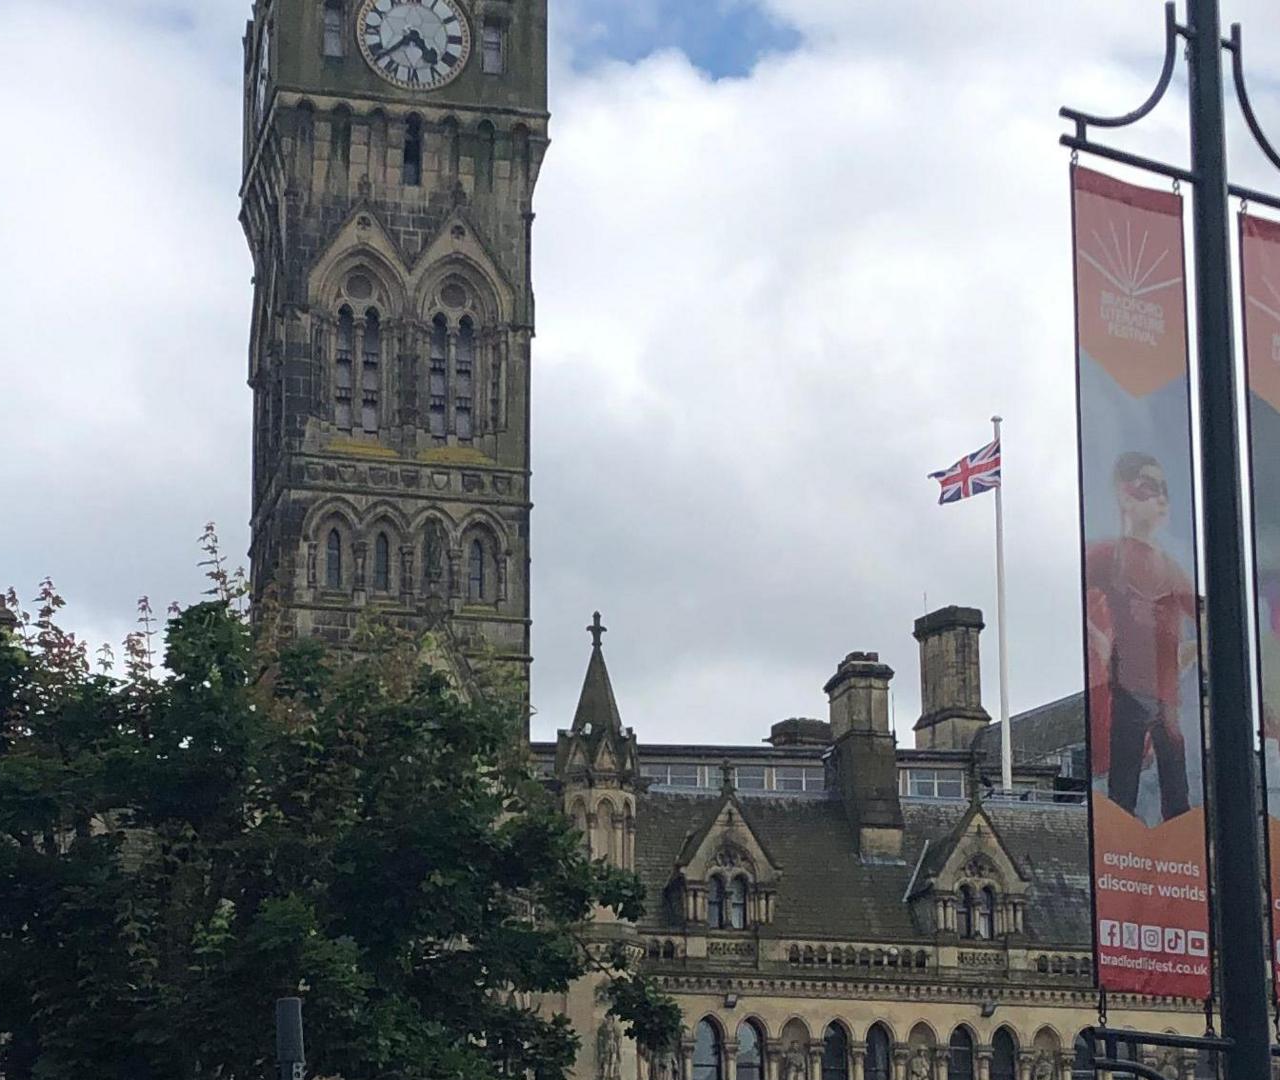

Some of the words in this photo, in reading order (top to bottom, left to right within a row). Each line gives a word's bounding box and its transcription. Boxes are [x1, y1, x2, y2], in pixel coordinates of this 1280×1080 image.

[1104, 852, 1153, 871] explore
[1155, 861, 1200, 877] words
[1098, 873, 1154, 896] discover
[1158, 884, 1207, 902] worlds
[1100, 952, 1208, 976] bradfordlitfest.co.uk
